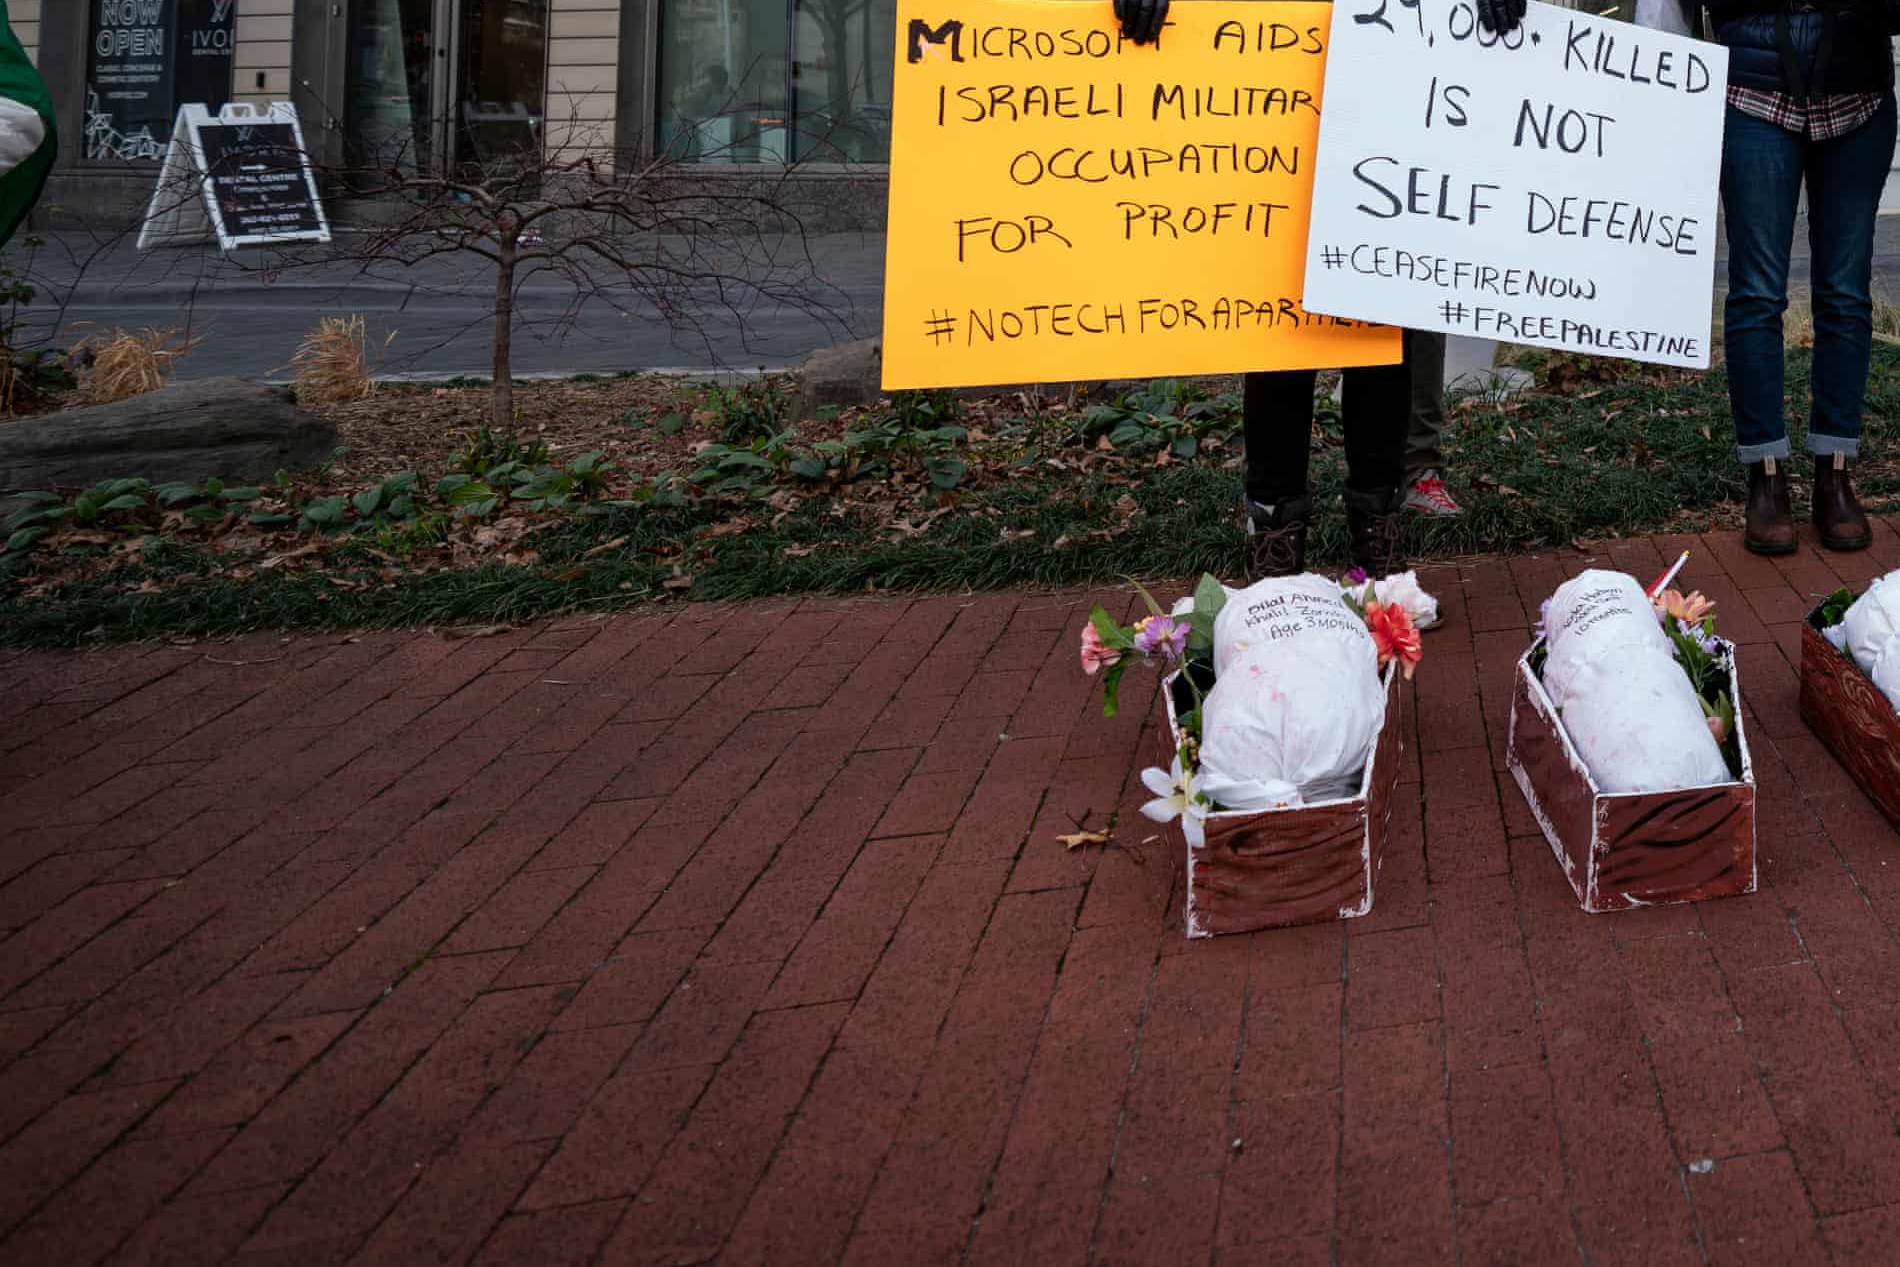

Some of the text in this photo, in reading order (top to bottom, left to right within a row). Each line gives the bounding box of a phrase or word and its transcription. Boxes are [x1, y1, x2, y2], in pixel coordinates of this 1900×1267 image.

[96, 29, 163, 57] OPEN
[1213, 21, 1324, 55] AIDS
[1565, 20, 1710, 94] KILLED
[938, 83, 1321, 126] ISRAELI MILITAR
[1425, 76, 1616, 158] IS NOT
[1010, 144, 1299, 185] OCCUPATION
[954, 202, 1289, 263] FOR PROFIT
[1352, 156, 1698, 255] SELF DEFENSE
[1320, 244, 1596, 300] #CEASEFIRENOW
[1440, 300, 1700, 359] #FREEPALESTINE
[1270, 621, 1302, 639] Age
